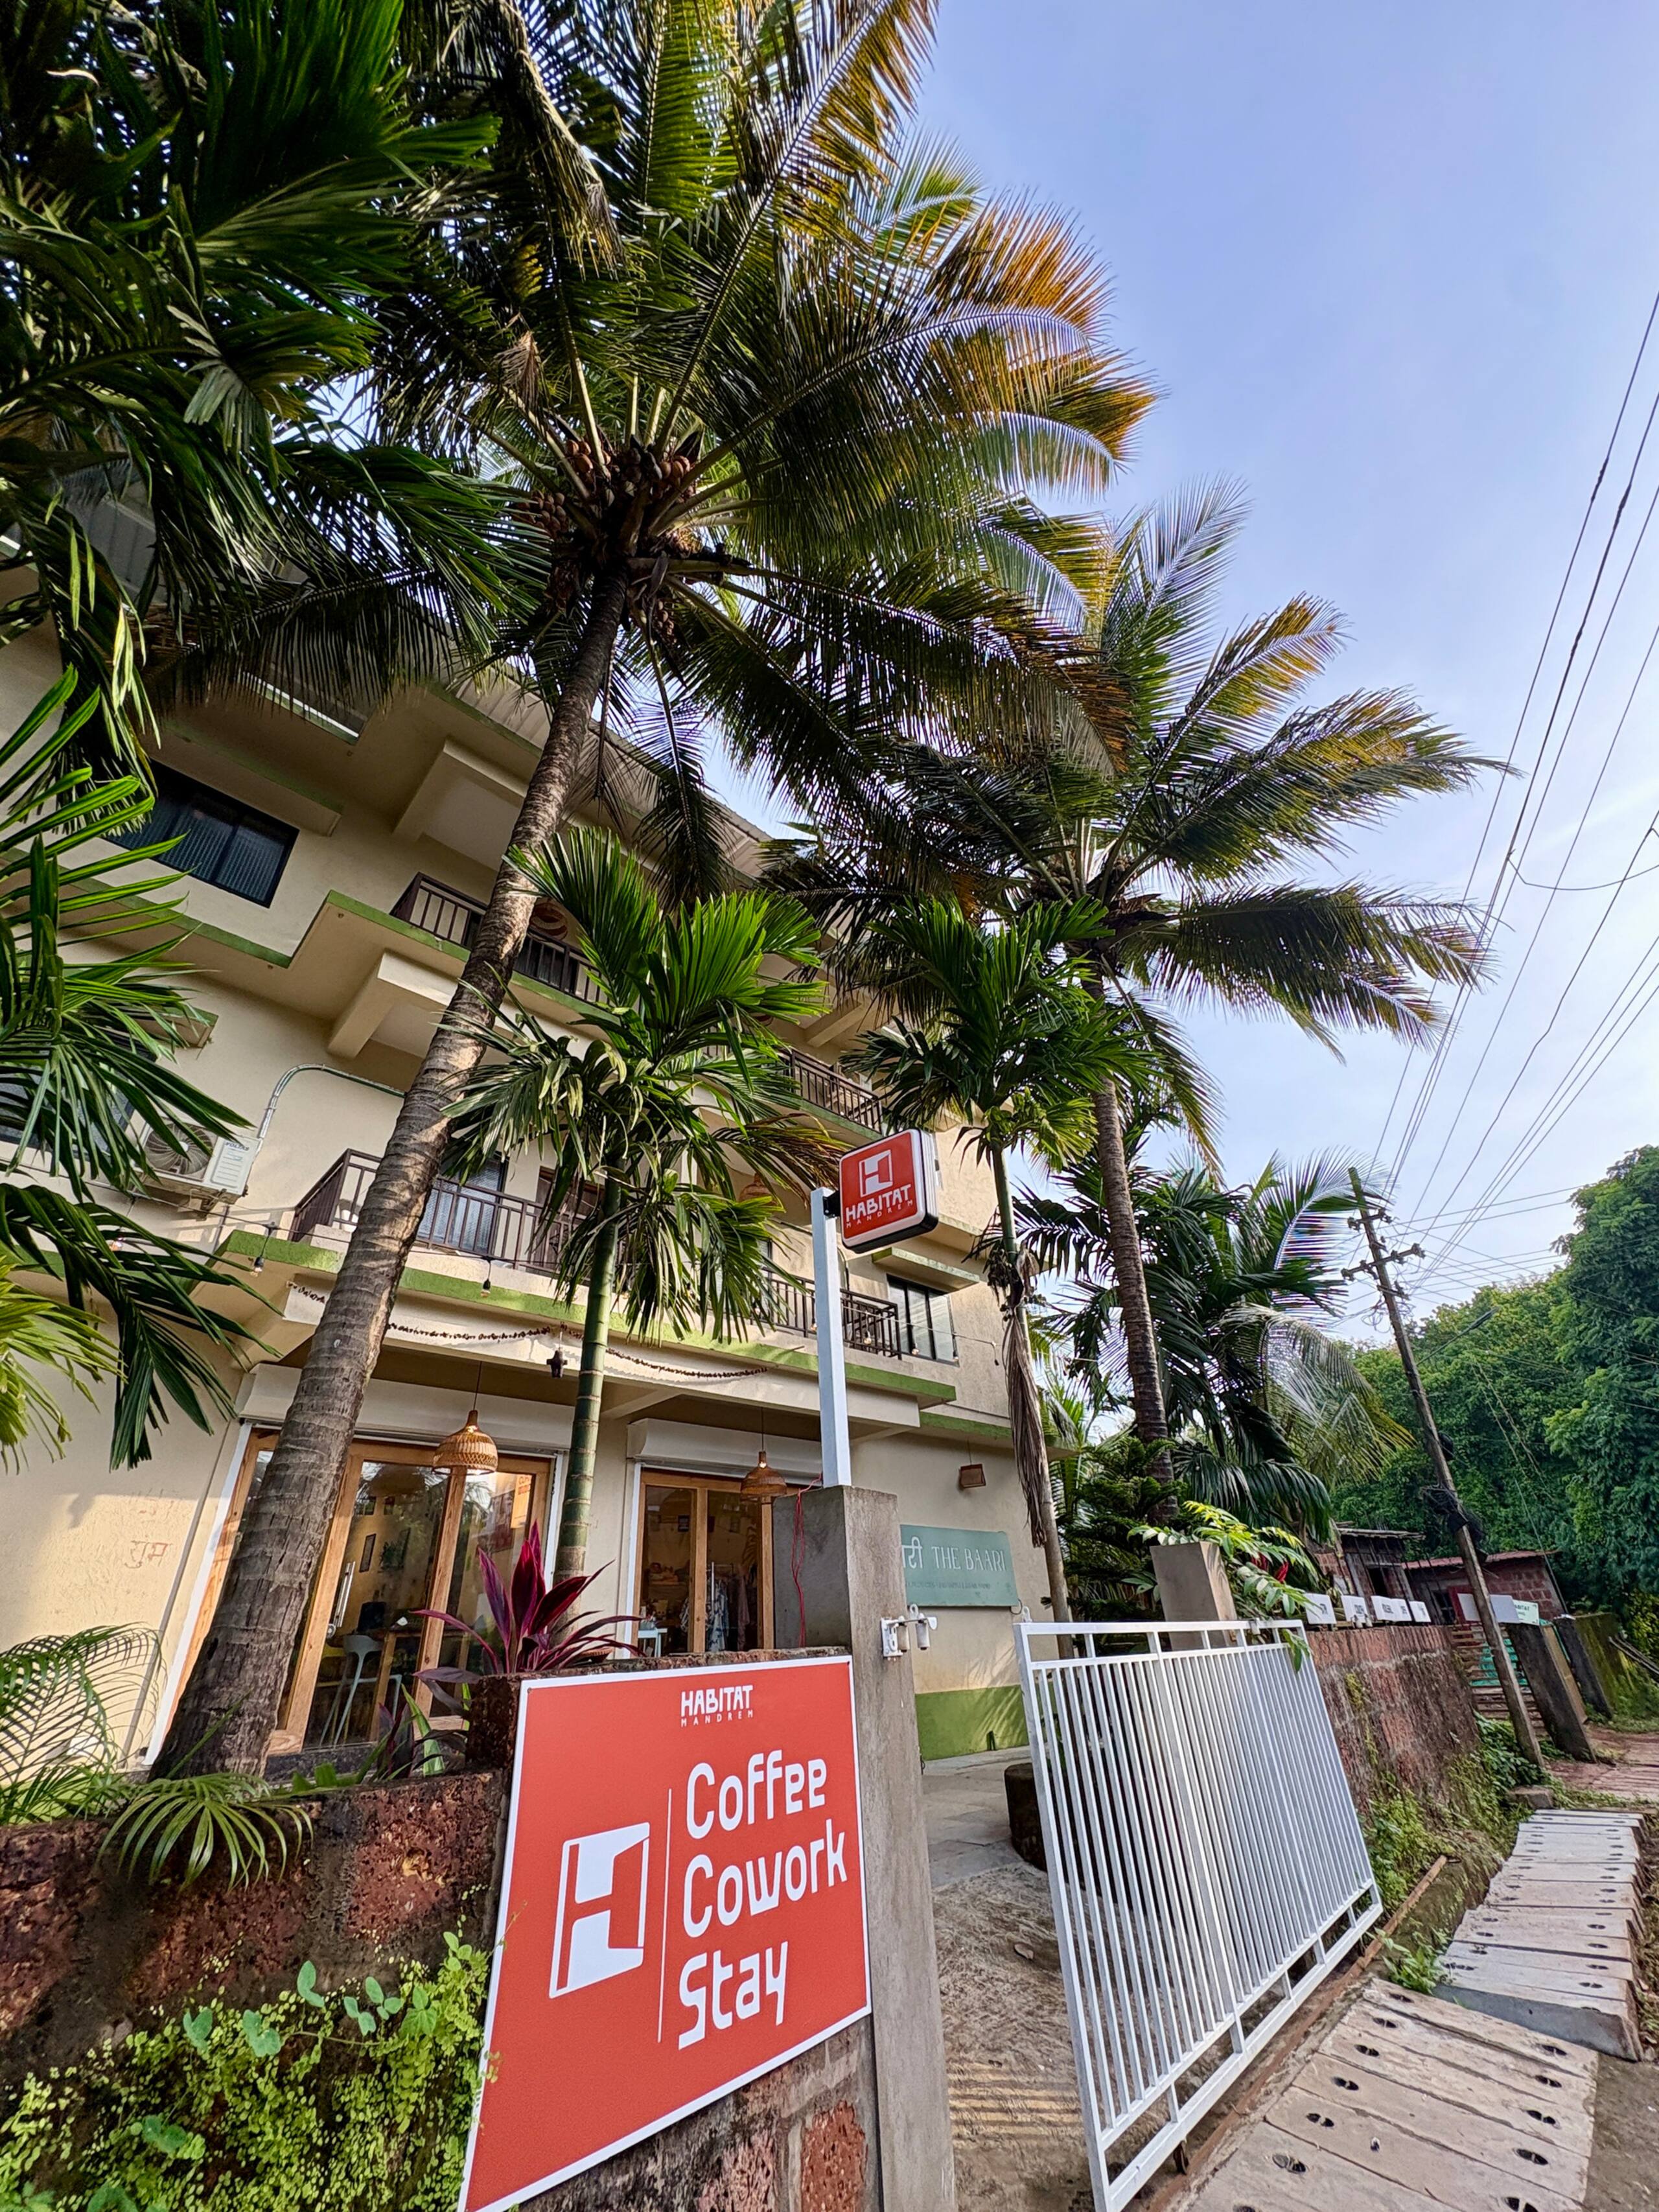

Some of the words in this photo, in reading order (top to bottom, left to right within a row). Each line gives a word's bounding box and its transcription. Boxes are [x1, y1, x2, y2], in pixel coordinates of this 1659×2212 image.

[845, 1183, 912, 1222] HABITAT
[846, 1200, 913, 1228] MANDREM
[931, 1546, 961, 1570] THE
[964, 1548, 1006, 1572] BAARI
[680, 1684, 753, 1717] HABITAT
[680, 1710, 754, 1727] MANDREM
[686, 1749, 827, 1839] Coffee
[683, 1819, 847, 1938] Cowork
[678, 1941, 788, 2050] Stay
